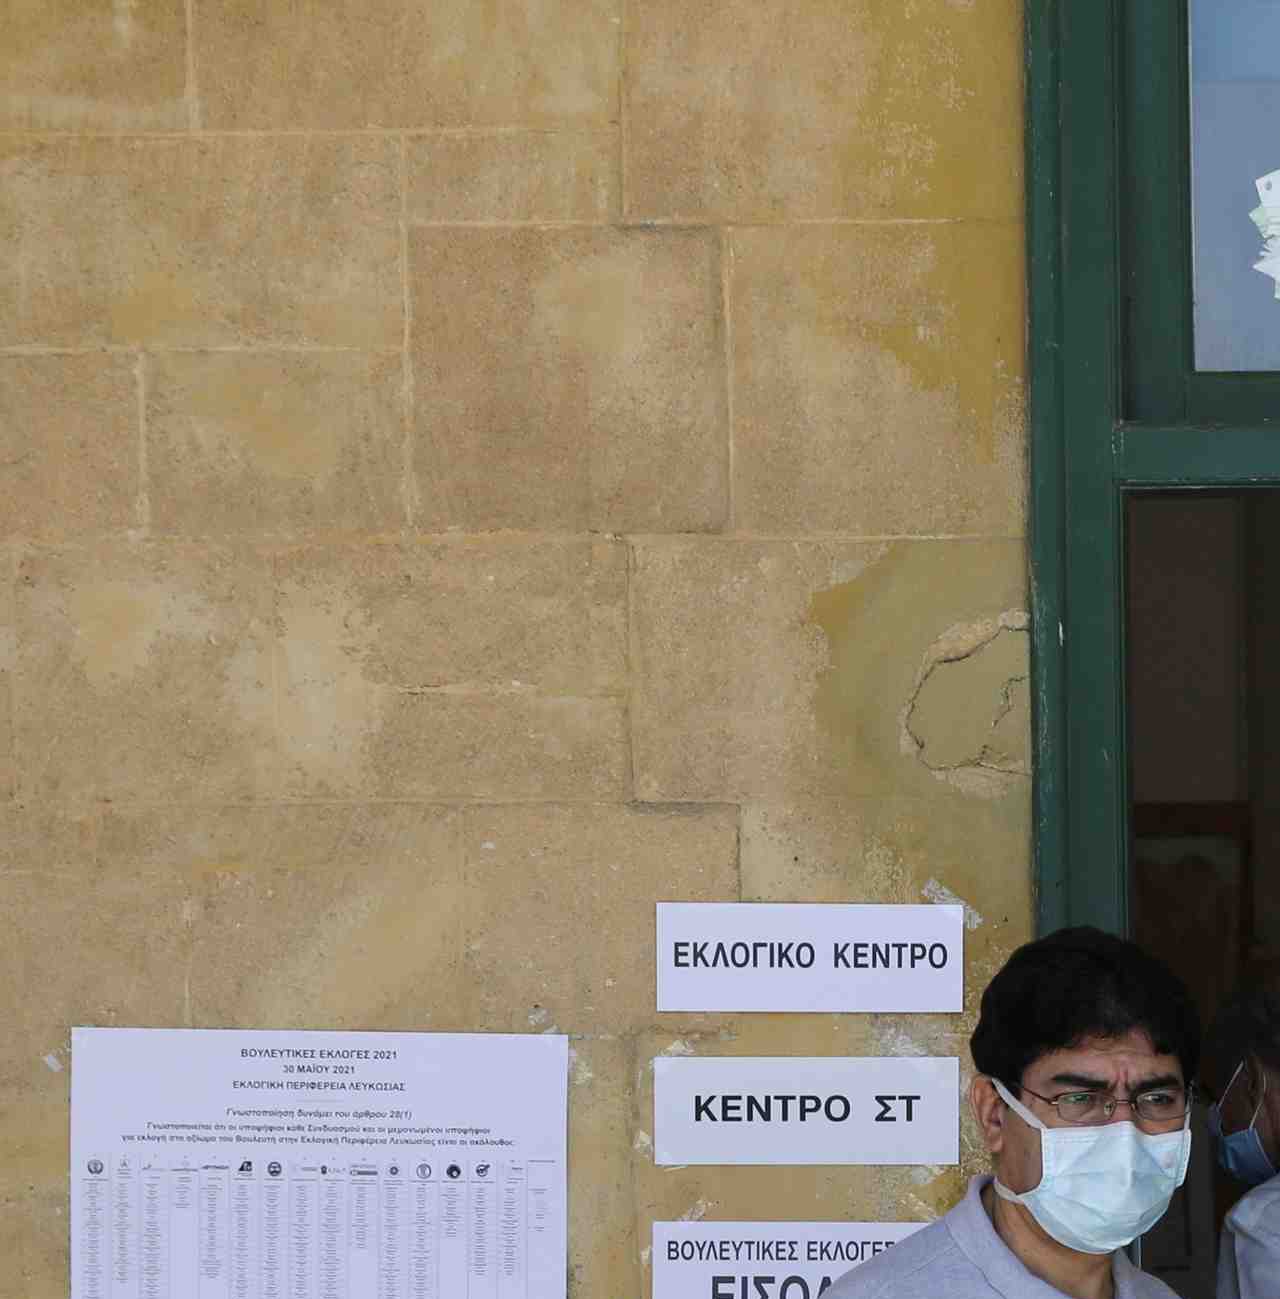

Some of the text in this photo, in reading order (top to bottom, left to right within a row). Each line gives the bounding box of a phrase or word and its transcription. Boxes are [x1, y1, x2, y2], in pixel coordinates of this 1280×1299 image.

[673, 941, 948, 969] ΕΚΛΟΓΙΚΟ ΚΕΝΤΡΟ
[240, 1048, 398, 1060] ΒΟΥΛΕΥΤΙΚΕΣ ΕΚΛΟΓΕΣ 2021
[333, 1065, 355, 1075] 2021
[232, 1080, 406, 1092] ΕΚΛΟΓΙΚΗ ΠΕΡΙΦΕΡΕΙΑ ΛΕΥΚΩΣΙΑΣ
[694, 1094, 921, 1122] ΚΕΝΤΡΟ ΣΤ
[667, 1240, 799, 1261] ΒΟΥΛΕΥΤΙΚΕΣ
